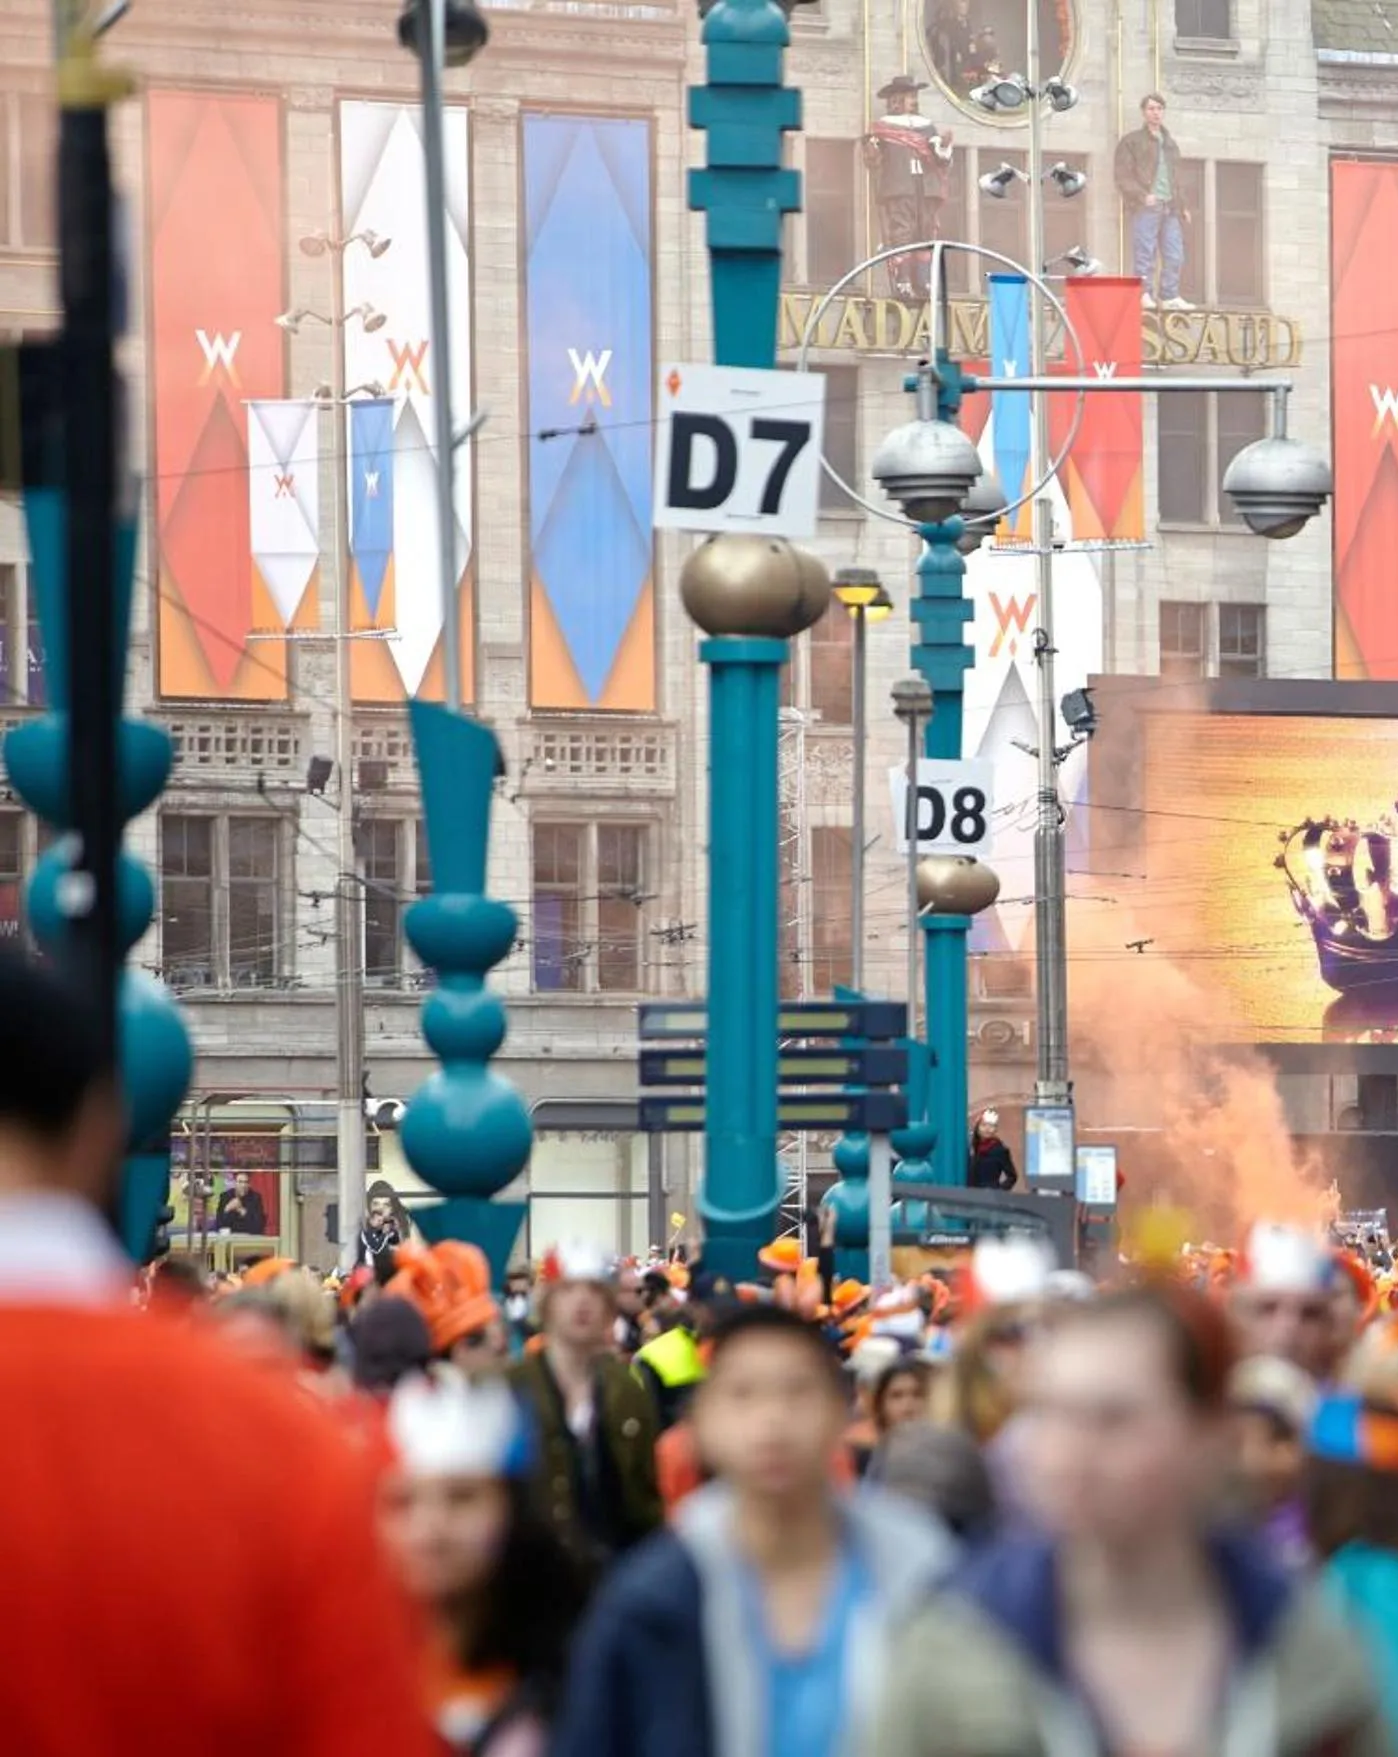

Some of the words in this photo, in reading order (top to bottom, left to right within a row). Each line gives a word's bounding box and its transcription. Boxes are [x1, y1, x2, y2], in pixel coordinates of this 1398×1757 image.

[775, 296, 1062, 360] MADAM
[1141, 311, 1302, 367] SSAUD
[667, 410, 811, 516] D7
[905, 786, 986, 844] D8
